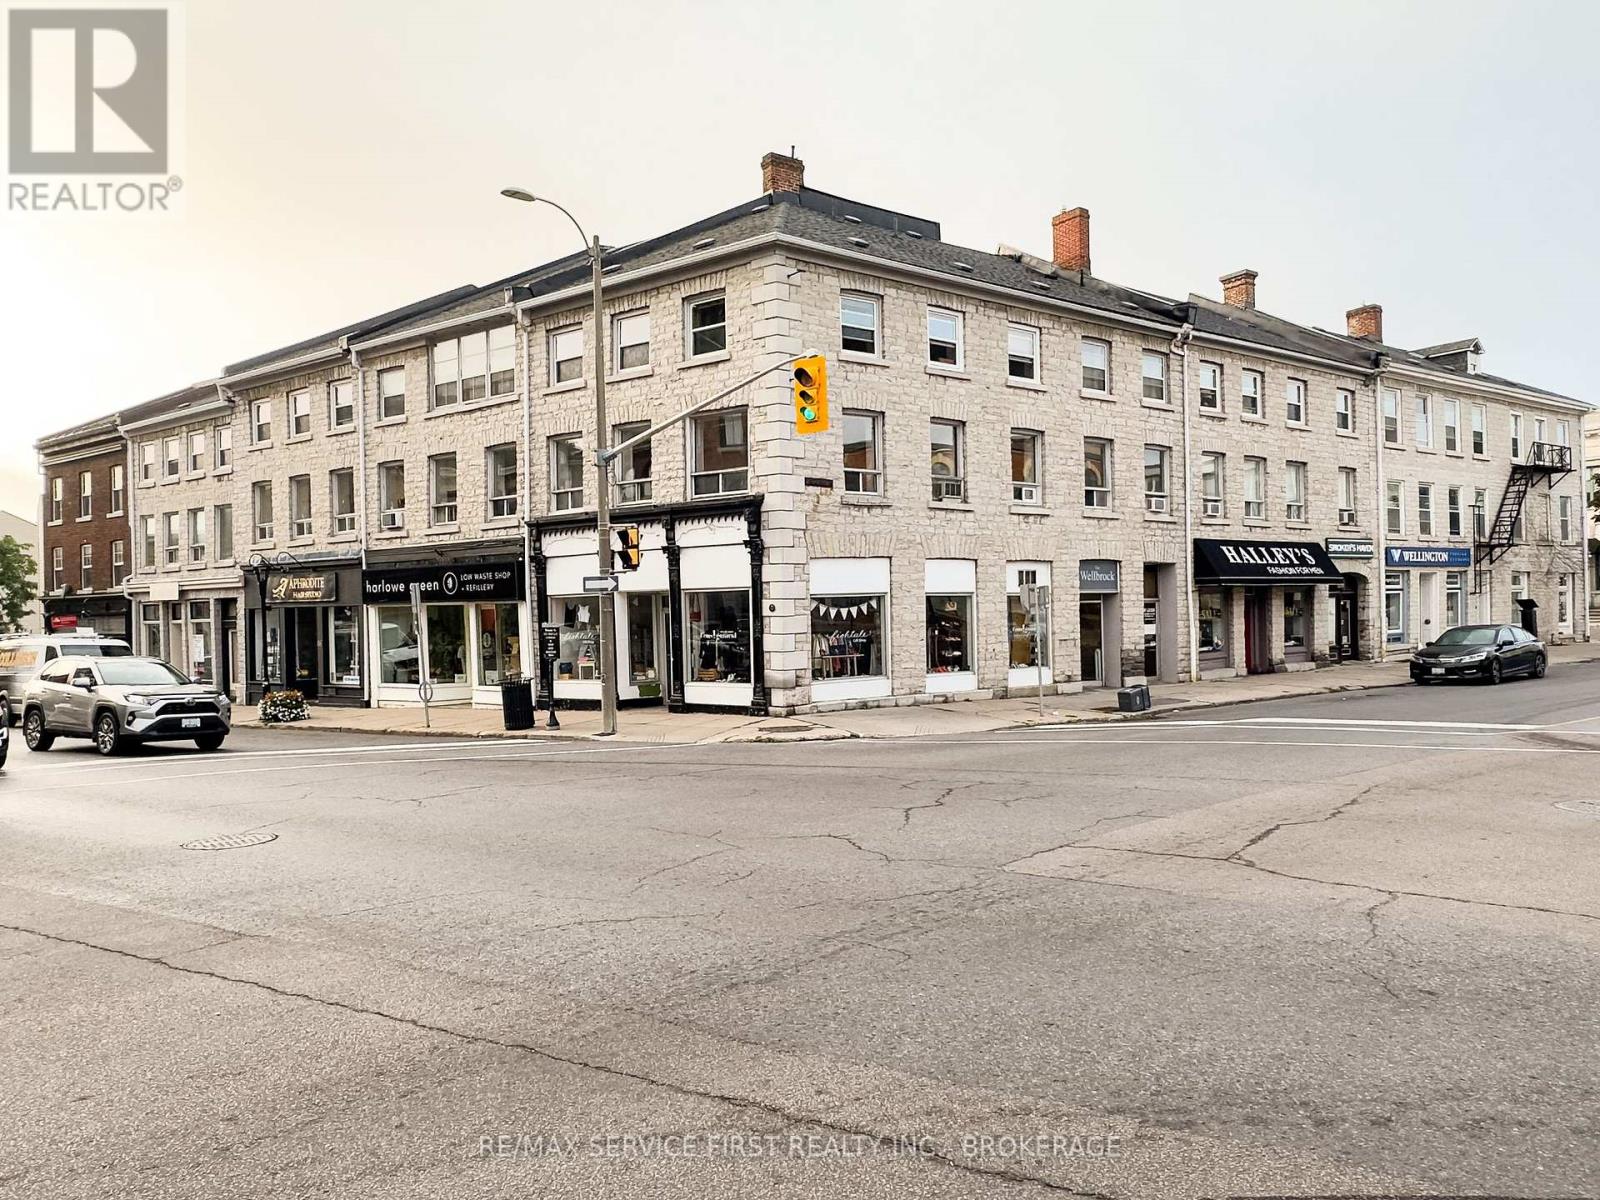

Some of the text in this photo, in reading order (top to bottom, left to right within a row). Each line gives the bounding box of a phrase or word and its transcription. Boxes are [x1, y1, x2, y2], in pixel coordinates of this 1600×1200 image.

[1219, 545, 1316, 565] HALLEY'S
[1402, 551, 1449, 562] WELLINGTON
[460, 571, 511, 581] LOW WASTE SHOP
[1080, 570, 1115, 581] Wellbrock
[1266, 566, 1297, 575] FASHION
[288, 576, 325, 589] APHRODITE
[365, 579, 440, 594] harlowe geen
[466, 583, 495, 592] REFILLERY
